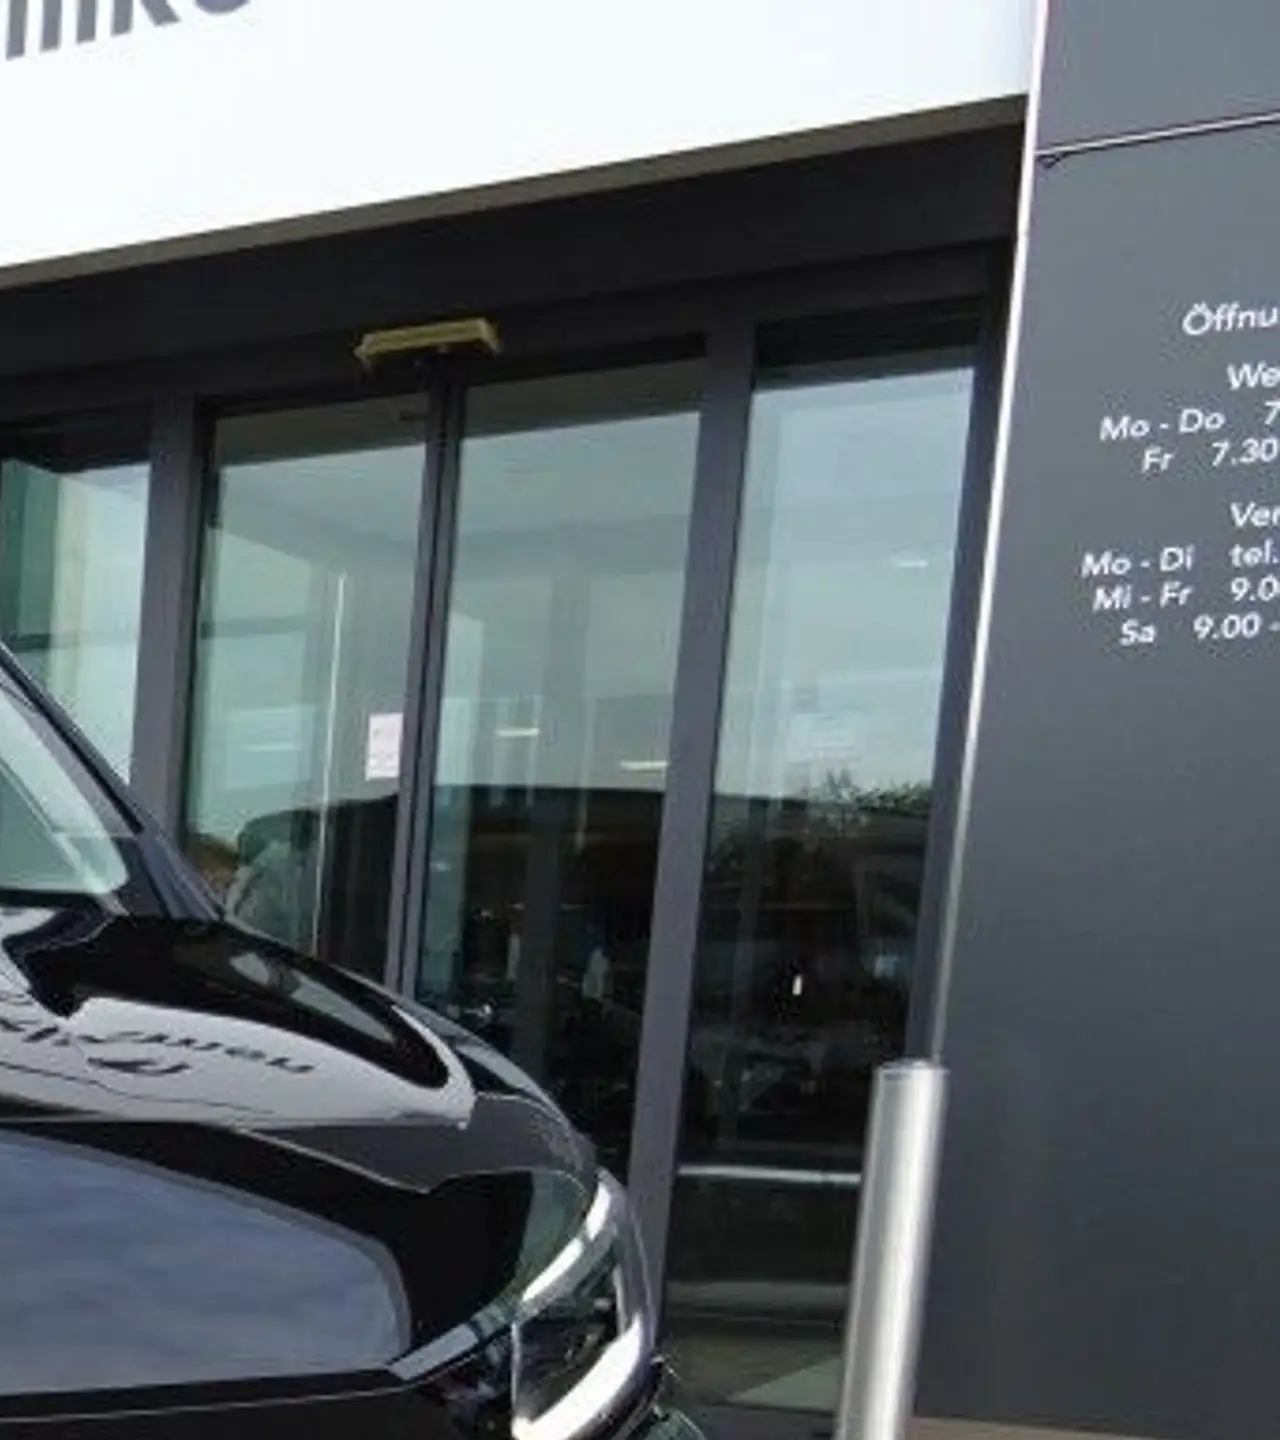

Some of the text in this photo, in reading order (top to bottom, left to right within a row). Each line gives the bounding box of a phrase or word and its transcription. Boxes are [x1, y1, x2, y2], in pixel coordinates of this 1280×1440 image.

[1182, 301, 1278, 335] Öffnu
[1100, 415, 1150, 441] Mo
[1179, 408, 1226, 433] Do
[1142, 437, 1278, 473] Fr 7.30
[1081, 551, 1132, 578] Mo
[1160, 545, 1195, 571] Di
[1093, 583, 1132, 612] Mi
[1160, 580, 1194, 608] Fr
[1120, 618, 1156, 646] Sa
[1193, 611, 1261, 640] 9.00
